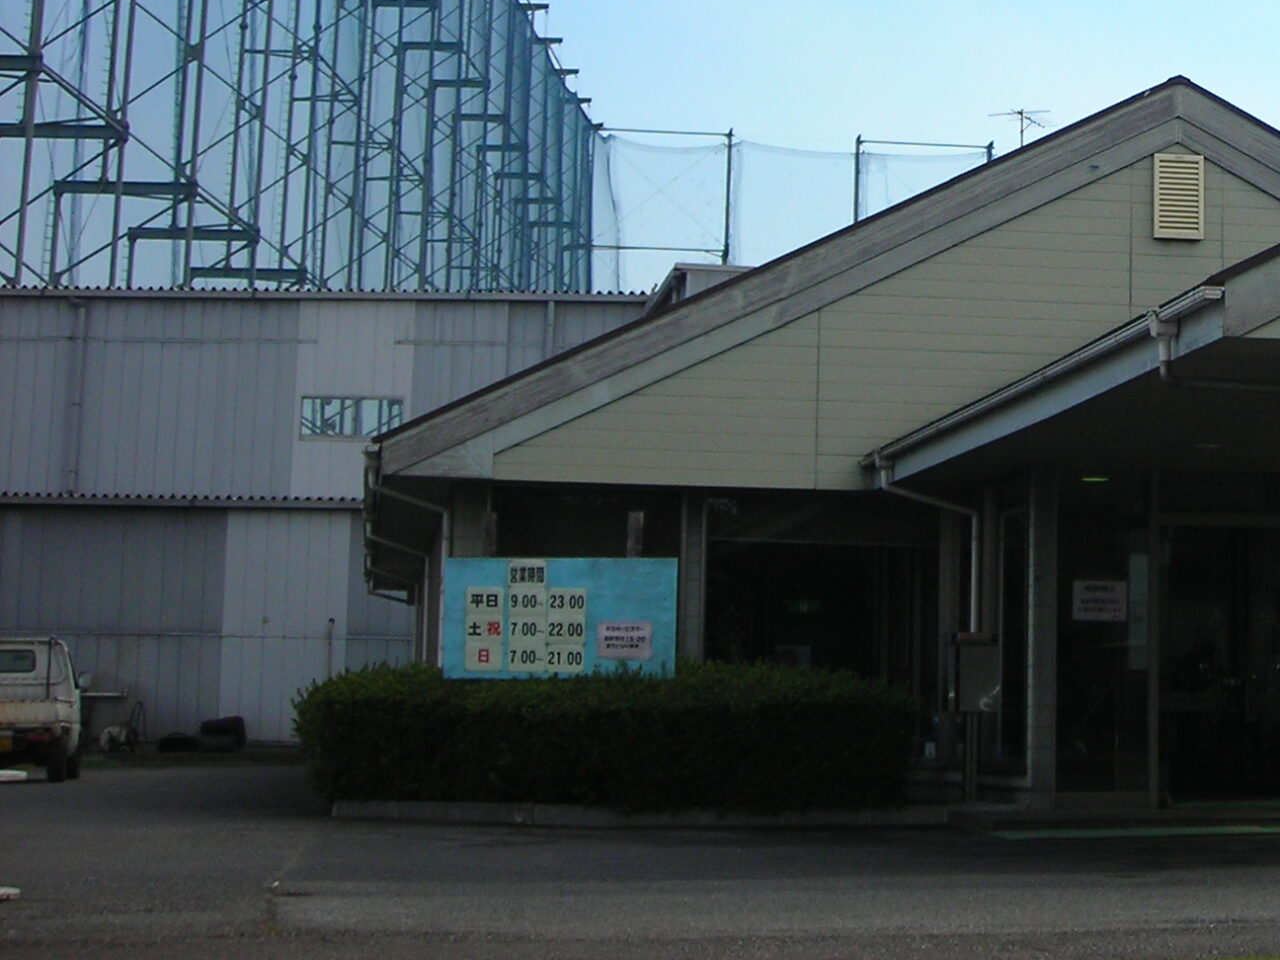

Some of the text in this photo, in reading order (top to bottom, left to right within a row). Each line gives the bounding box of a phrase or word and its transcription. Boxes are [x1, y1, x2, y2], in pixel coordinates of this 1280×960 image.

[510, 567, 545, 584] 営業時間
[470, 593, 499, 608] 平日
[477, 649, 489, 663] 日
